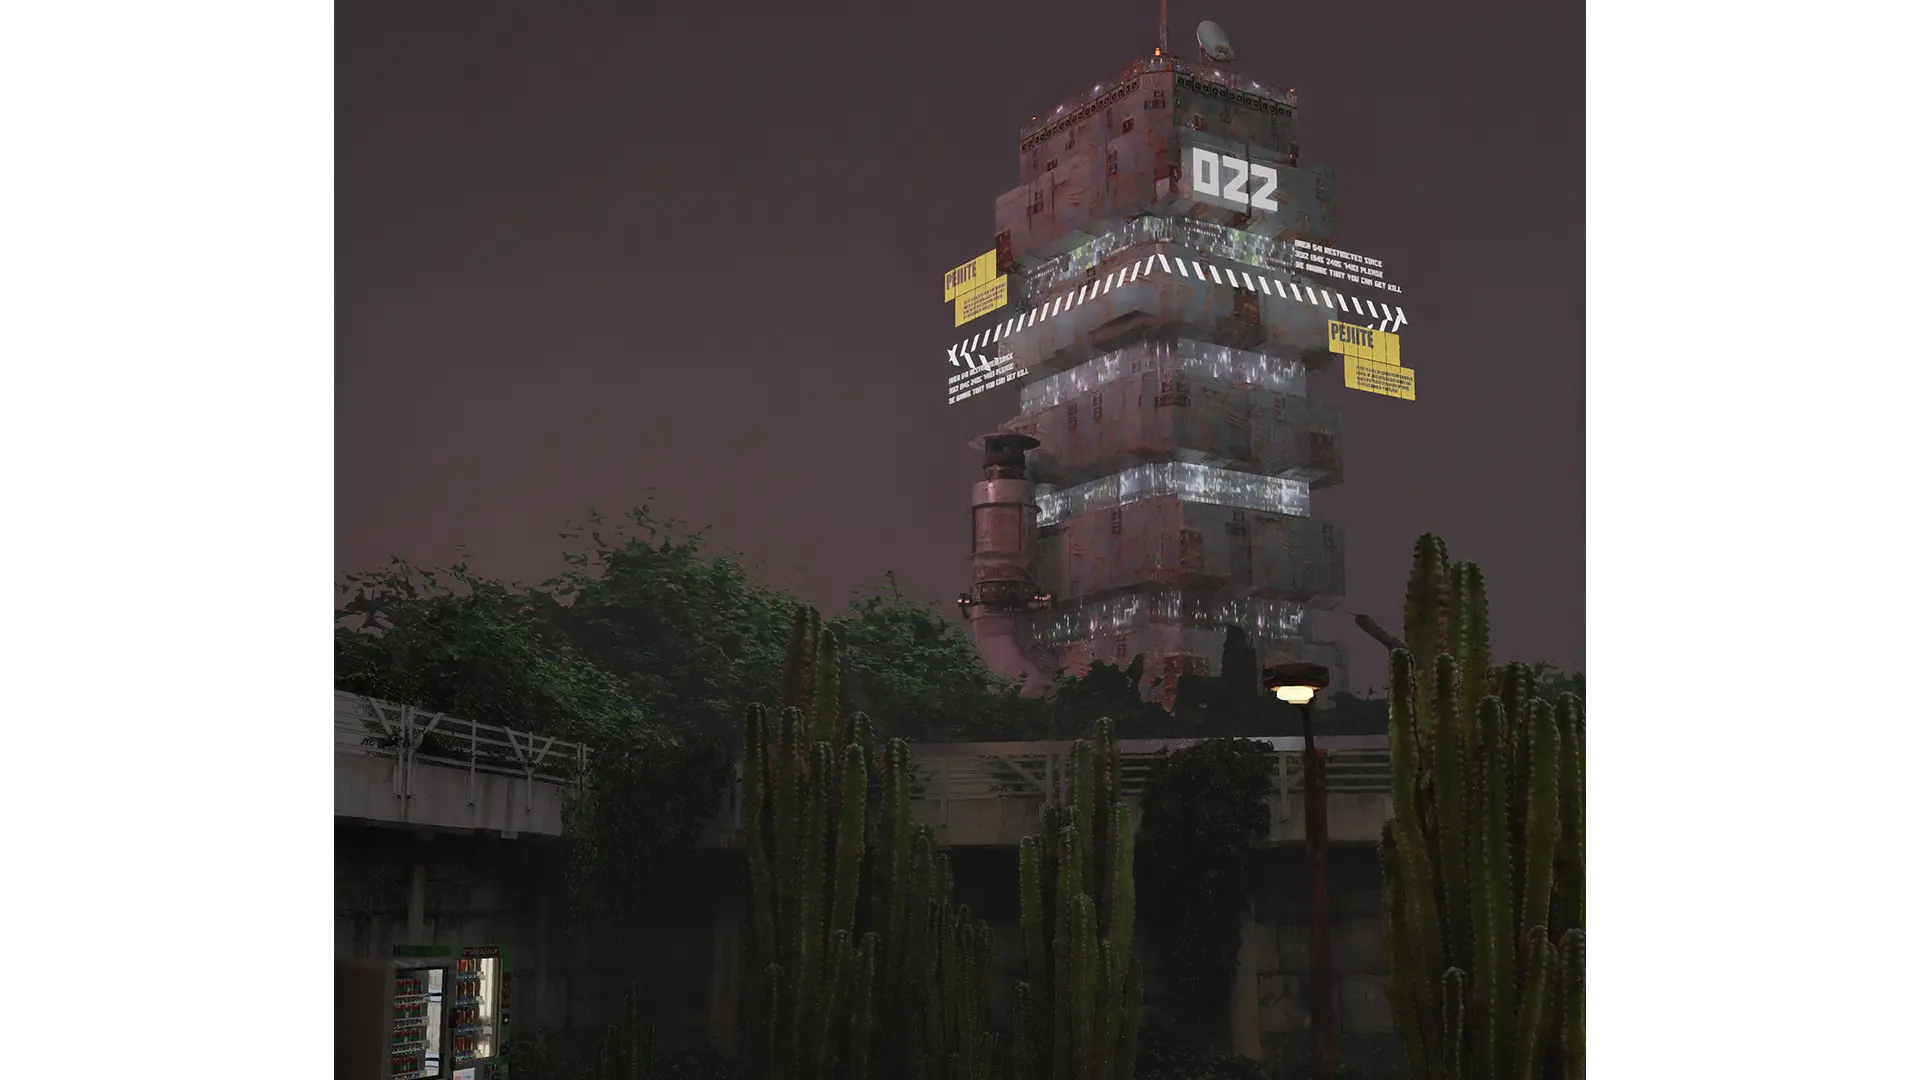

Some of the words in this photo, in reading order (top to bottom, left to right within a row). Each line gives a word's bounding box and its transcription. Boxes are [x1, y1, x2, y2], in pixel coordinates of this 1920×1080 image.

[1192, 147, 1278, 212] 022
[1324, 247, 1362, 263] RESTRICTED
[1364, 257, 1382, 268] SINCE
[1329, 269, 1345, 280] THAT
[1347, 274, 1359, 283] YOU
[1360, 278, 1372, 287] CAN
[1374, 281, 1386, 290] GET
[1387, 285, 1402, 294] KILL
[1360, 267, 1383, 279] PLEASE
[985, 380, 995, 390] YOU
[1017, 368, 1028, 378] KILL
